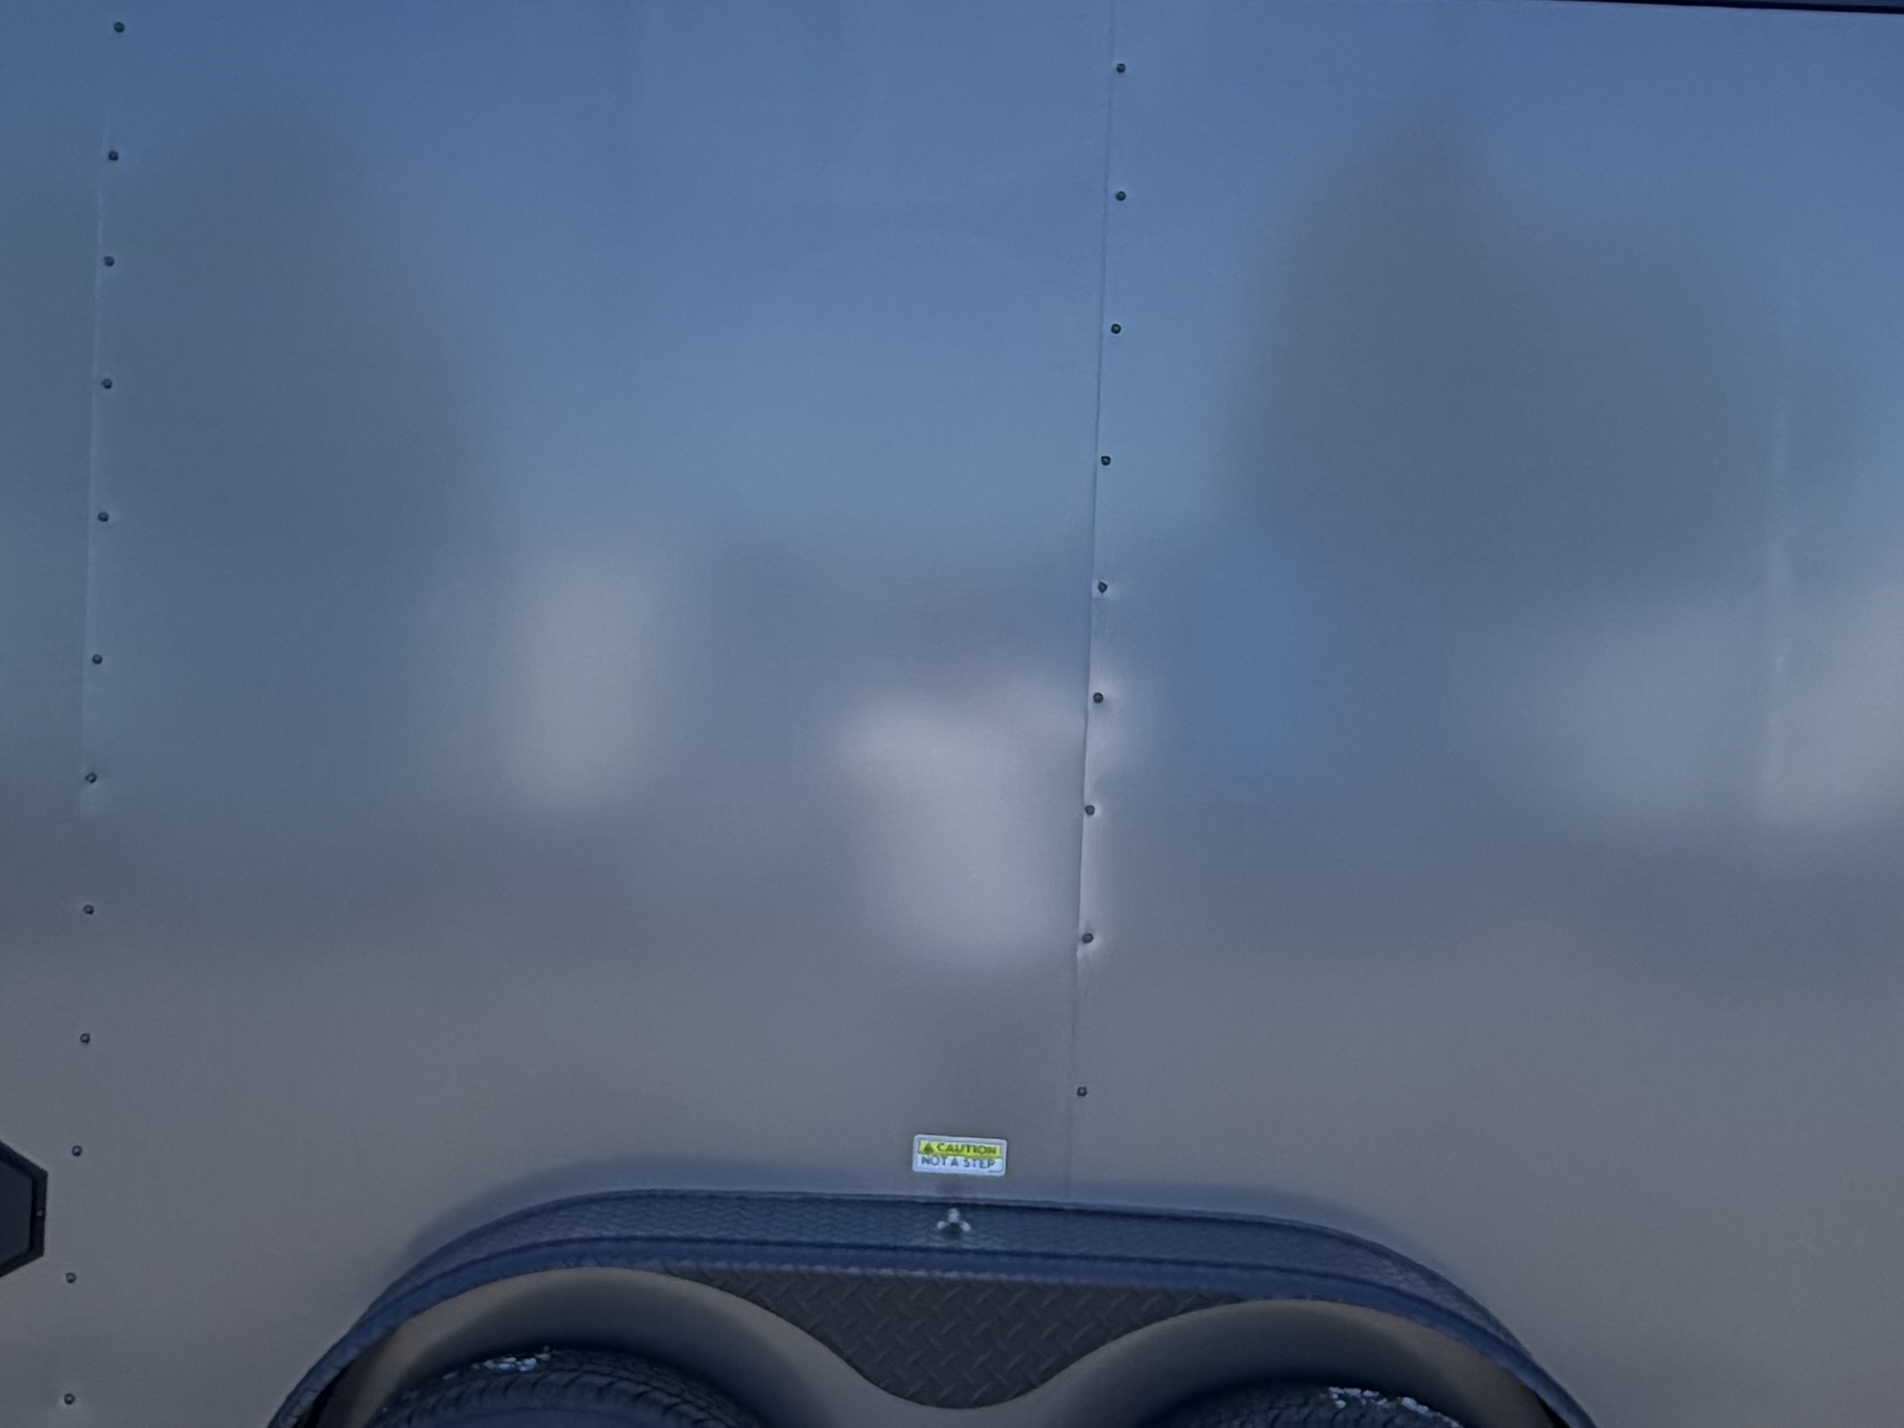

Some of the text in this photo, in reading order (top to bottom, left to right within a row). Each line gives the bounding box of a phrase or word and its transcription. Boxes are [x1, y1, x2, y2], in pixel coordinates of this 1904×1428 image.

[937, 1143, 996, 1154] CAUTION
[921, 1155, 996, 1169] NOT A STEP
